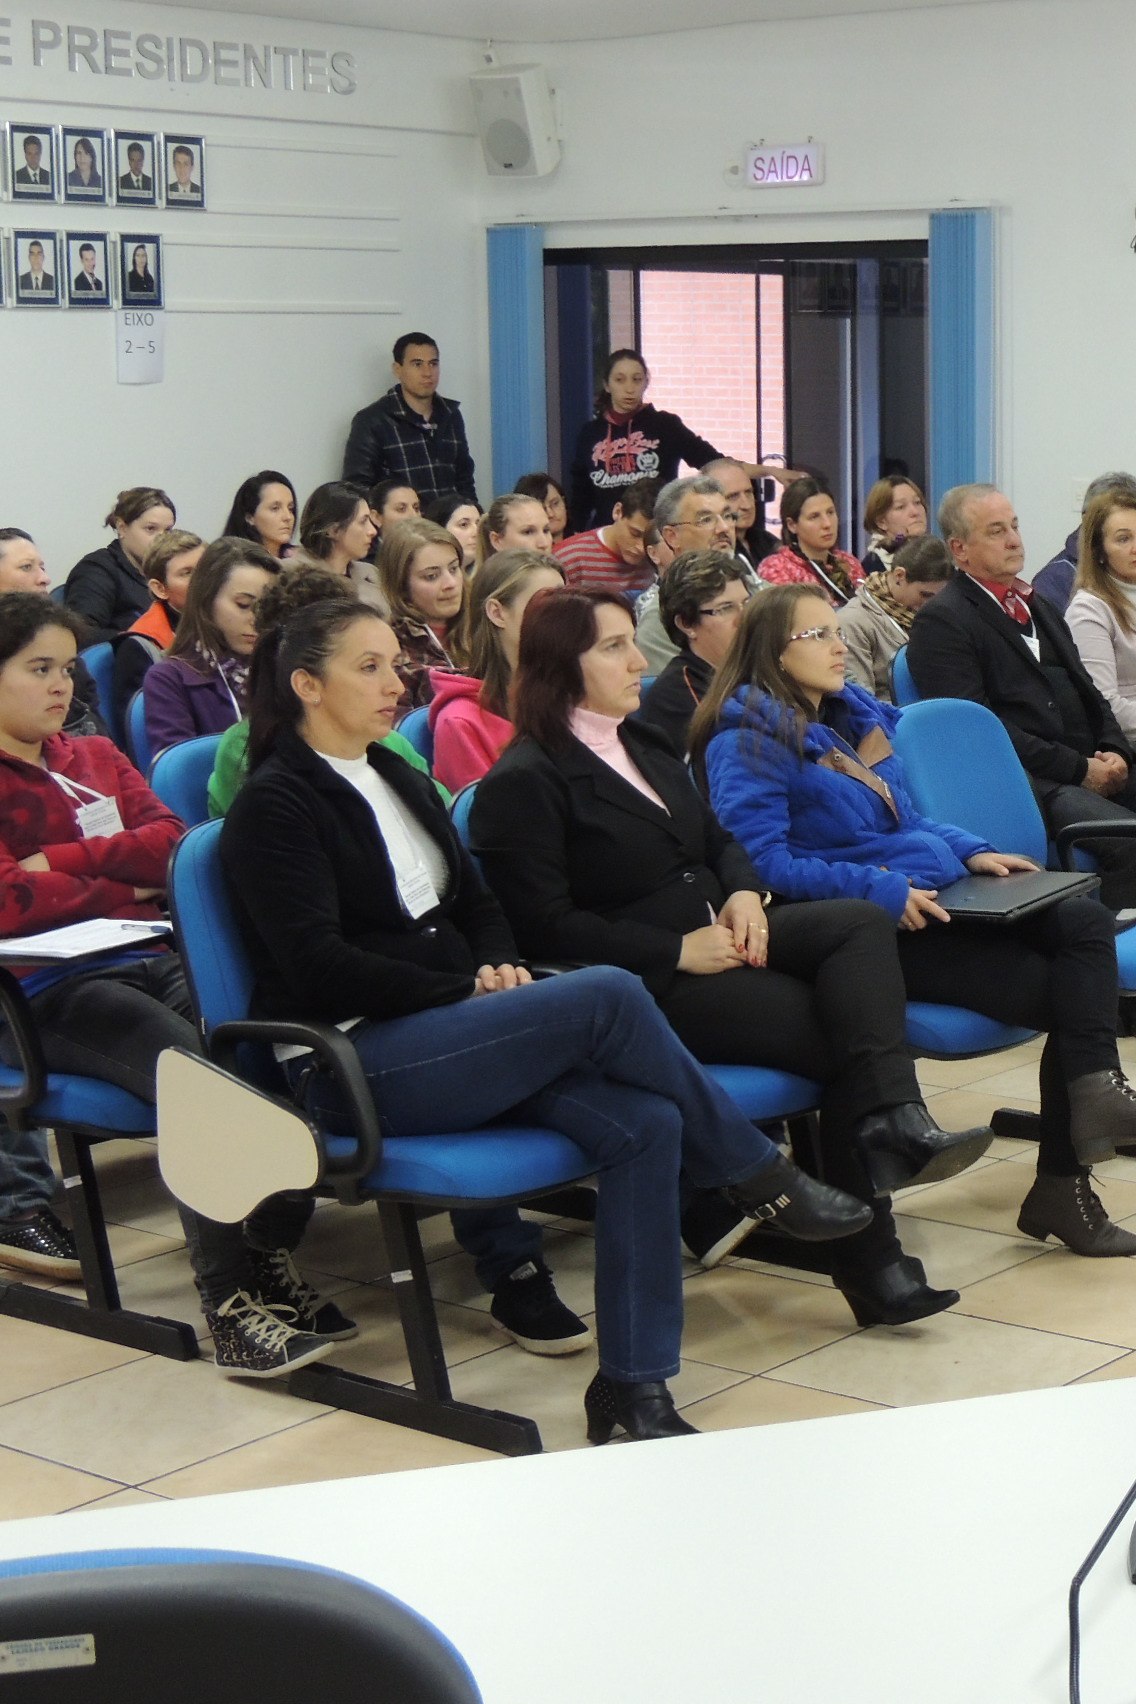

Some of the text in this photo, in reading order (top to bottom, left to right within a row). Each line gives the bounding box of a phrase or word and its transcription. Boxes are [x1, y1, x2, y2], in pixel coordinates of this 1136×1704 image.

[31, 19, 358, 95] PRESIDENTES
[753, 150, 812, 181] SAÍDA
[124, 312, 154, 327] EIXO
